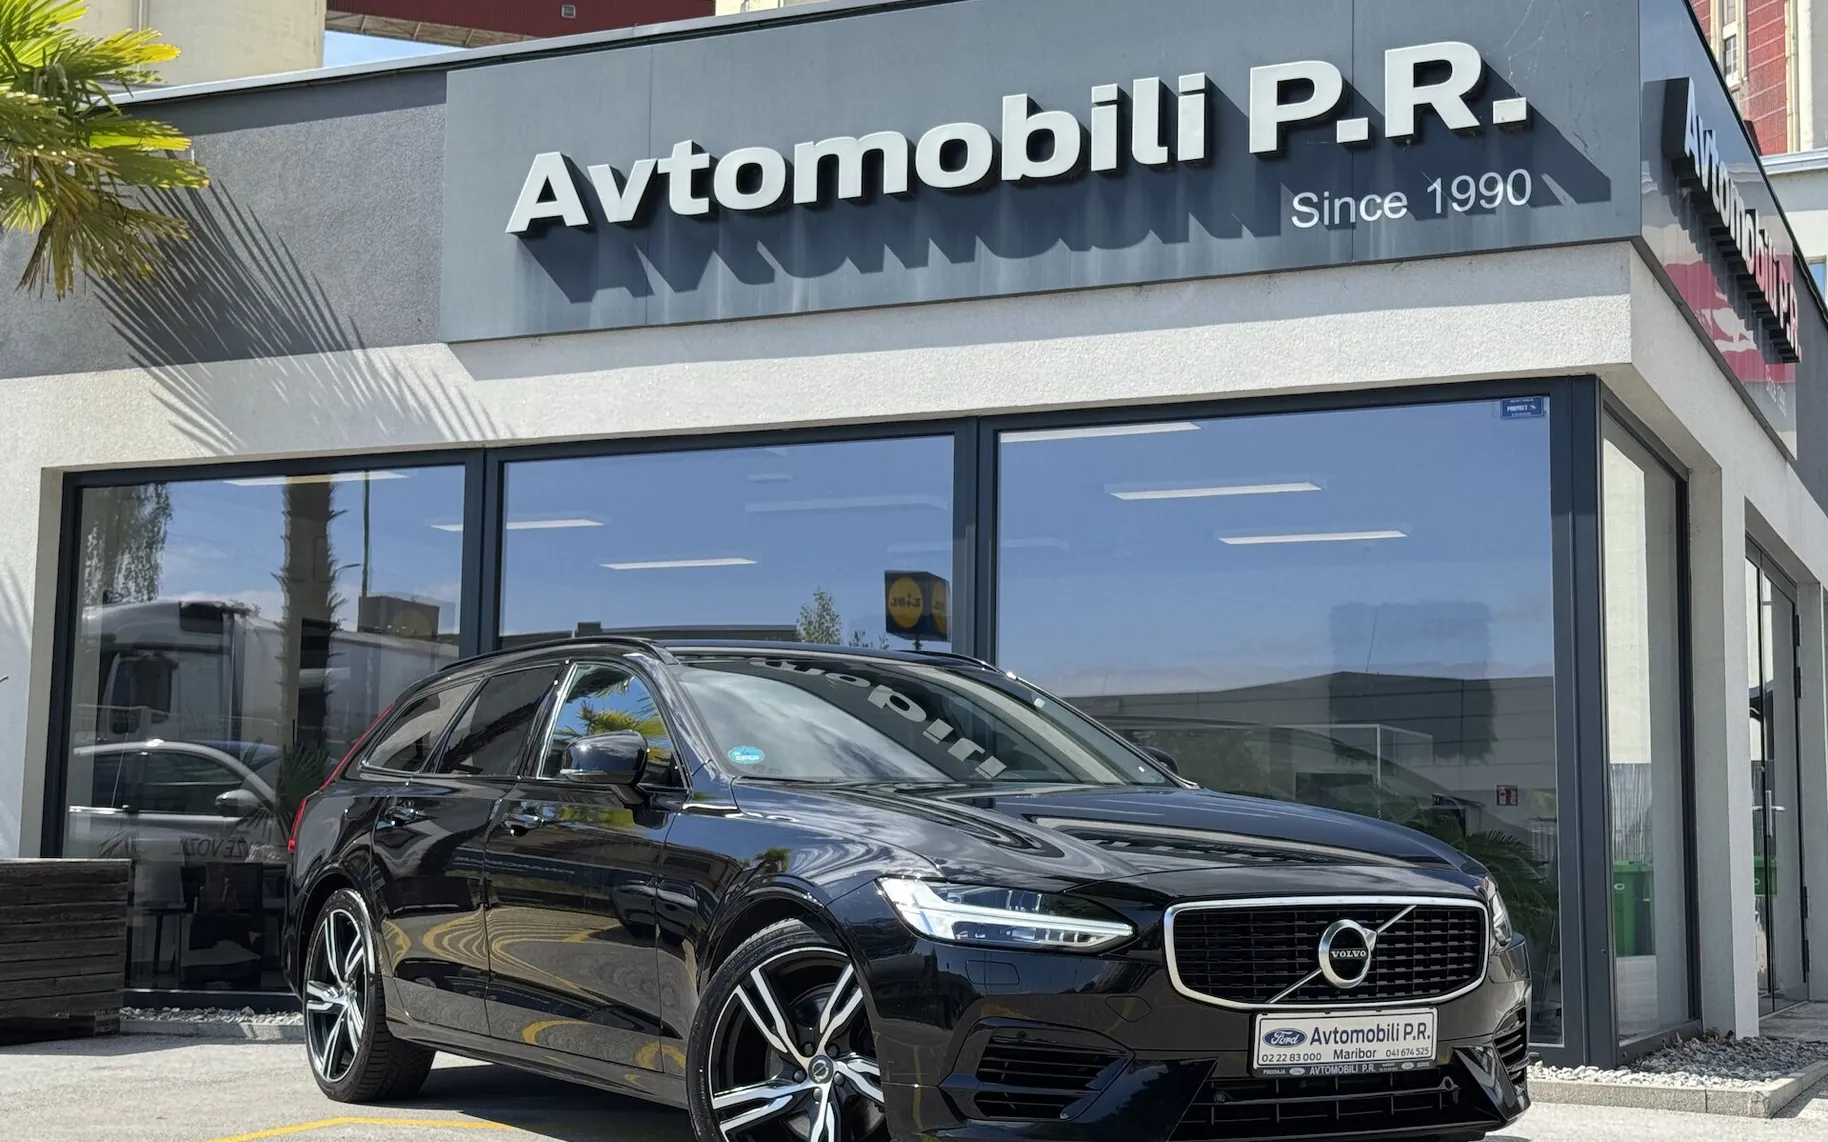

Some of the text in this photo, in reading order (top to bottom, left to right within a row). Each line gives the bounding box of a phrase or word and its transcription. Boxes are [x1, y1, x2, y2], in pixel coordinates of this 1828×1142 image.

[505, 41, 1526, 233] Avtomobili P.R.
[1291, 169, 1532, 228] Since 1990
[1331, 950, 1366, 958] VOLVO
[1310, 1022, 1431, 1046] Avtomobili P.R.
[1262, 1052, 1322, 1062] 02 22 83 000
[1333, 1047, 1377, 1060] Maribor
[1386, 1047, 1430, 1057] 041 674 525
[1309, 1064, 1358, 1075] AVTOMOBILI
[1362, 1064, 1376, 1073] P.R.
